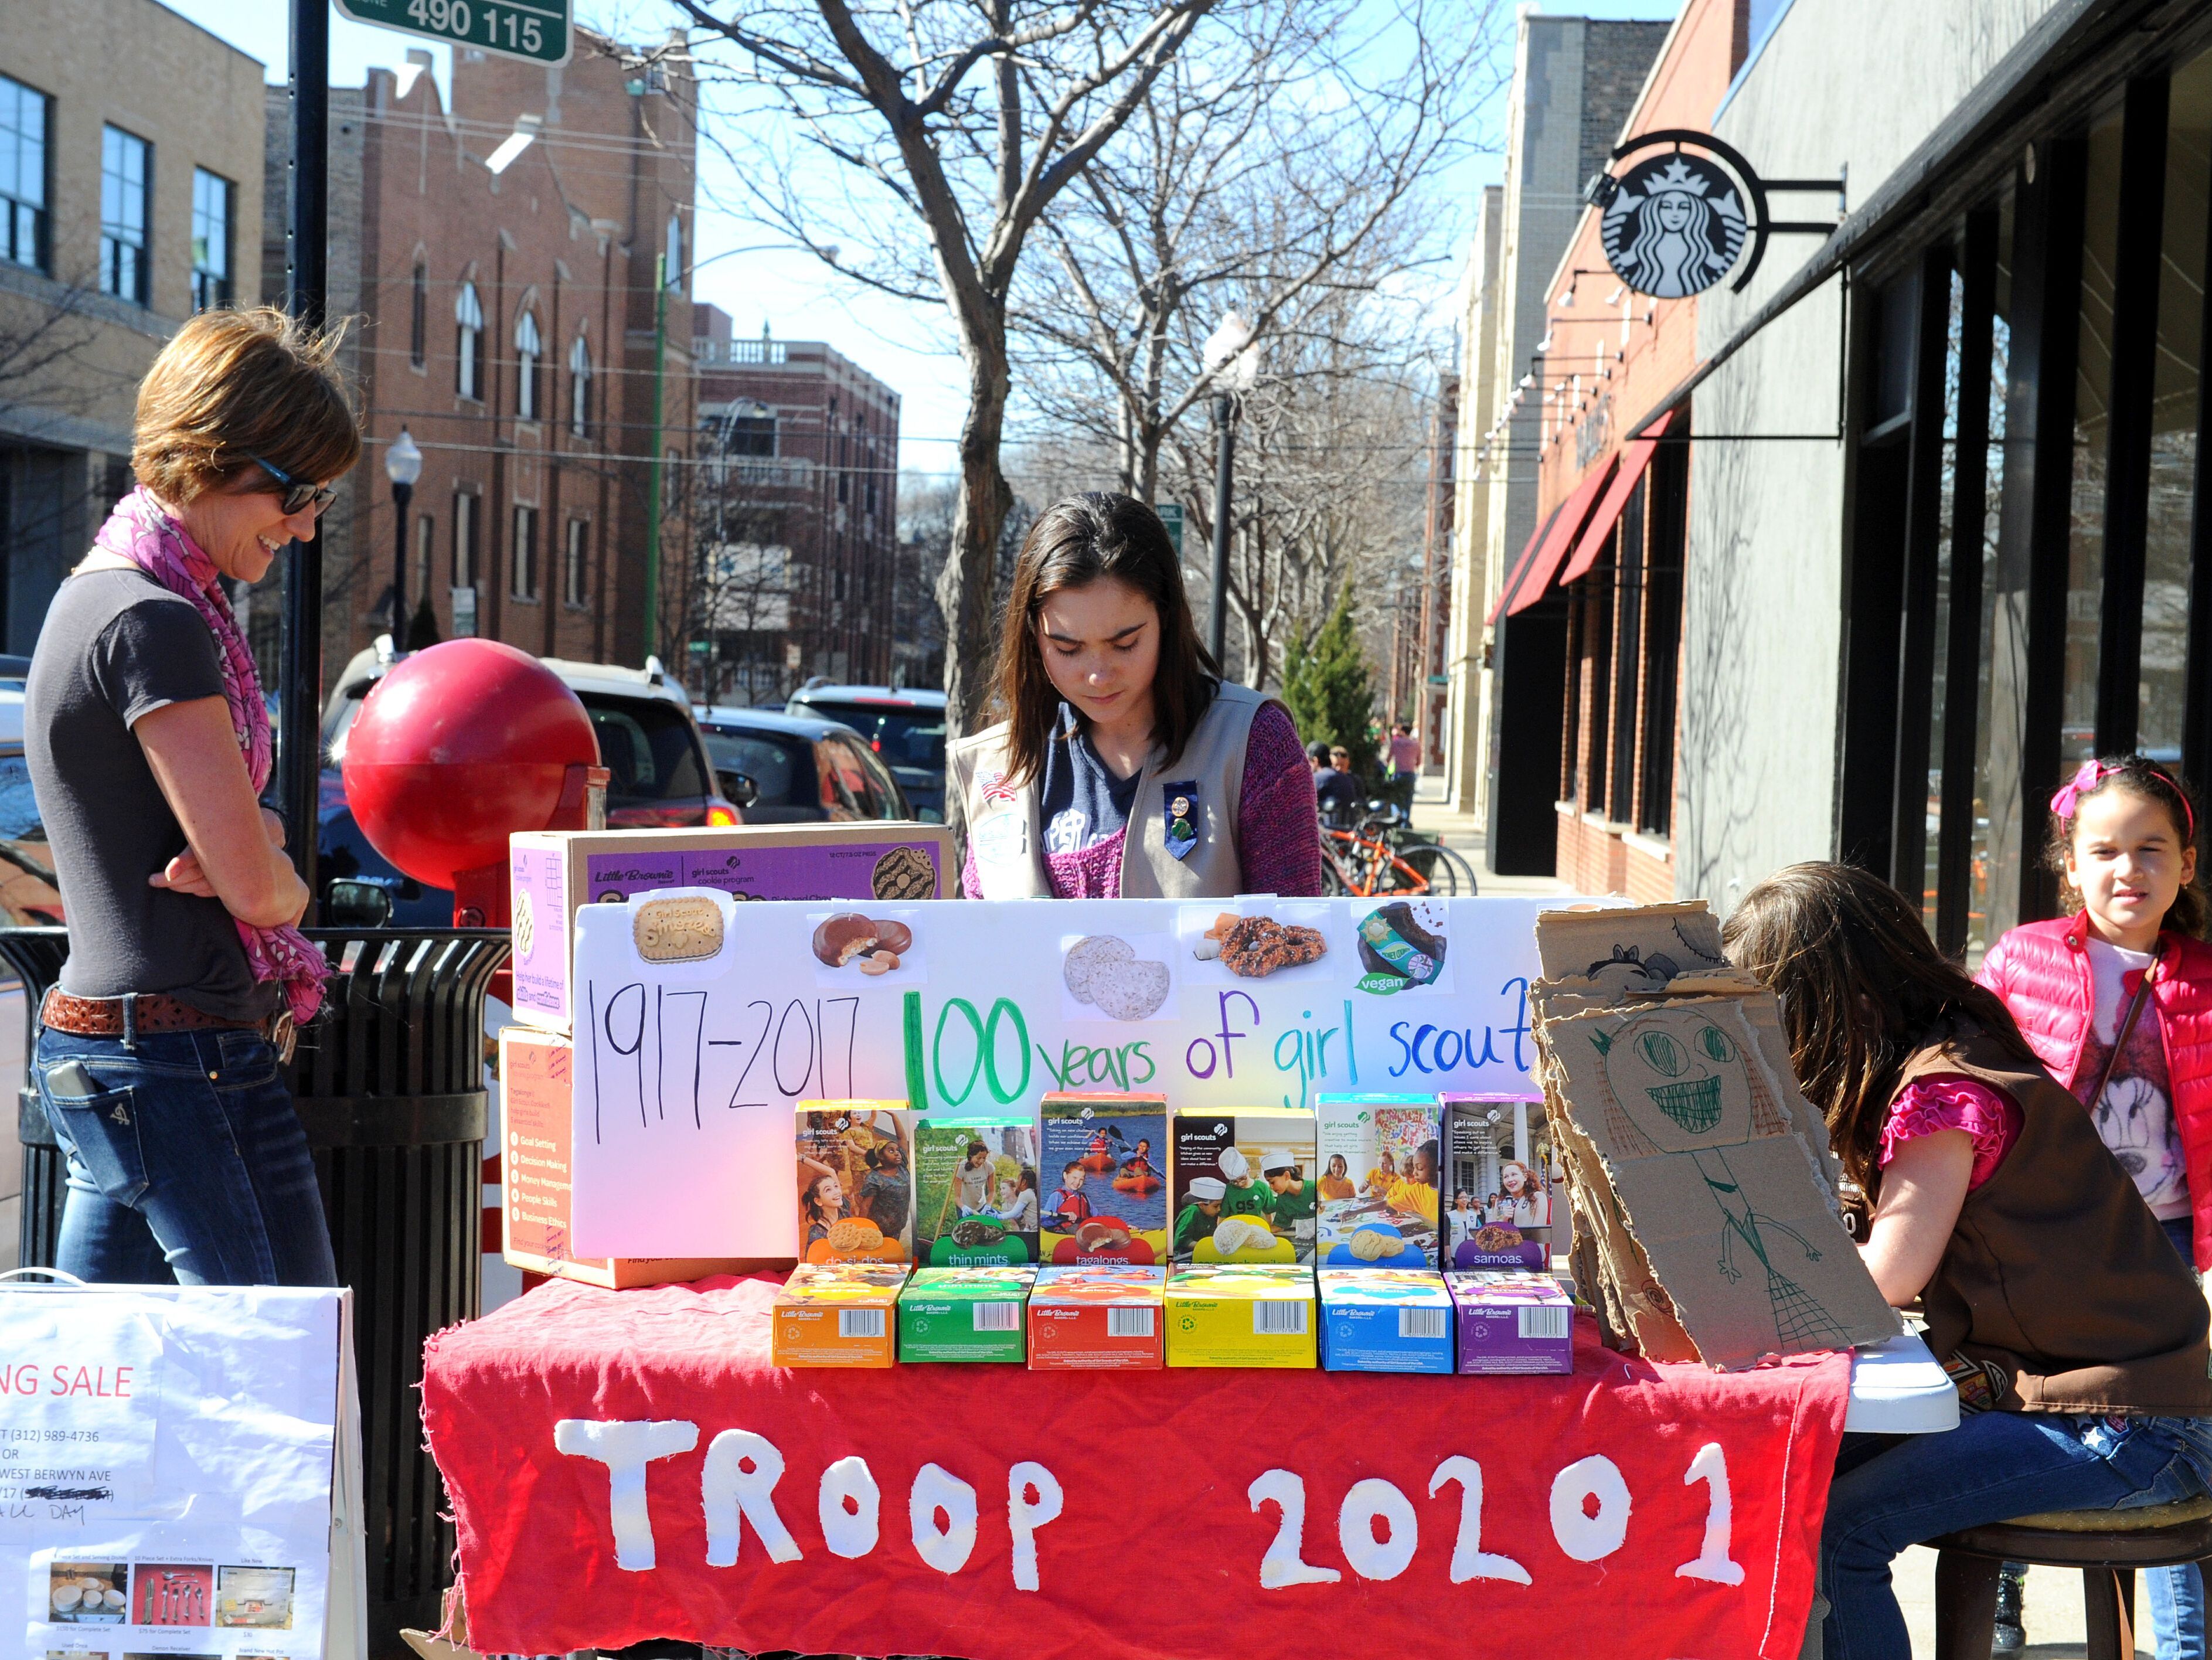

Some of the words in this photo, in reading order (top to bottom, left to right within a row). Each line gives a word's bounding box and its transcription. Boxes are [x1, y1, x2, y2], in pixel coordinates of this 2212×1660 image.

[407, 0, 471, 36] 490
[483, 9, 543, 53] 115
[595, 871, 624, 883] Little
[625, 870, 673, 880] Brownie
[692, 868, 705, 878] girl
[723, 876, 754, 885] program
[656, 910, 671, 919] Girl
[674, 909, 704, 917] Scout
[1362, 978, 1403, 991] vegan
[903, 991, 1031, 1111] 100
[1036, 1039, 1156, 1093] years
[1186, 990, 1260, 1080] of
[1274, 999, 1355, 1109] girl
[1048, 1117, 1060, 1125] girl
[1454, 1120, 1465, 1128] girl
[803, 1128, 815, 1137] girl
[1181, 1133, 1193, 1142] girl
[520, 1136, 534, 1147] Goal
[535, 1137, 556, 1152] Setting
[923, 1145, 934, 1154] girl
[520, 1155, 545, 1167] Decision
[546, 1159, 567, 1173] Making
[521, 1173, 540, 1186] Money
[522, 1192, 541, 1205] People
[542, 1196, 557, 1207] Skills
[1236, 1200, 1254, 1213] gs
[522, 1212, 547, 1224] Business
[549, 1216, 567, 1229] Ethics
[948, 1254, 972, 1265] thin
[974, 1254, 1008, 1265] mints
[50, 1365, 134, 1397] SALE
[11, 1429, 40, 1443] (312)
[44, 1430, 99, 1442] 989-4736
[2, 1448, 19, 1459] OR
[0, 1469, 31, 1479] WEST
[34, 1469, 84, 1481] BERWYN
[89, 1471, 111, 1481] AVE
[553, 1419, 1064, 1591] TROOP
[1248, 1442, 1745, 1590] 20201
[49, 1504, 84, 1525] DAY
